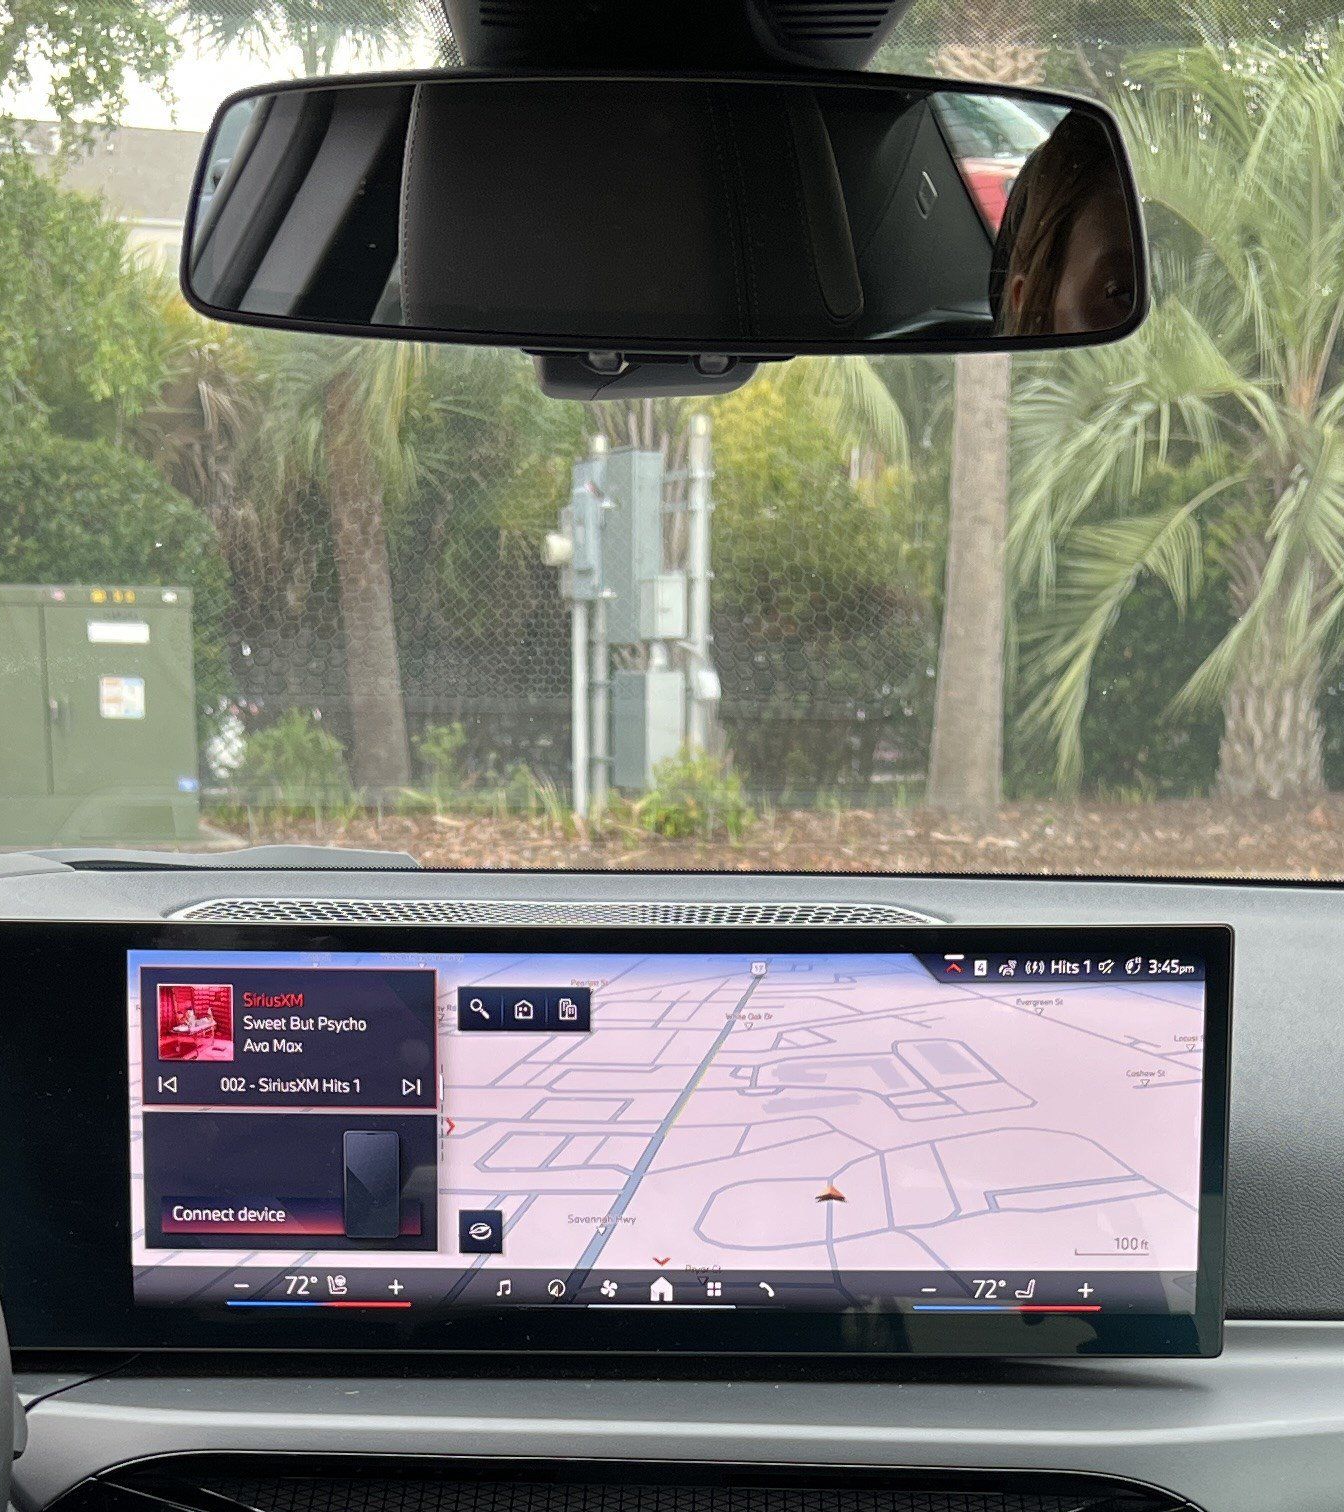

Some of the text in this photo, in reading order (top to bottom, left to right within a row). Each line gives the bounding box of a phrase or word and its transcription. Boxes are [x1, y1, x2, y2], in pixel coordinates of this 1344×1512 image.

[1050, 960, 1091, 974] Hits 1
[242, 992, 304, 1008] SiriusXM
[1016, 998, 1054, 1007] Evergreen
[243, 1016, 367, 1036] Sweet But Psycho
[243, 1038, 303, 1054] Ava Max
[220, 1078, 246, 1093] 002
[259, 1078, 319, 1094] SiriusXM
[322, 1078, 350, 1094] Hits
[353, 1079, 361, 1094] 1
[172, 1205, 286, 1222] Connect device
[1114, 1237, 1139, 1250] 100
[285, 1276, 318, 1296] 72°
[972, 1278, 1007, 1298] 72°
